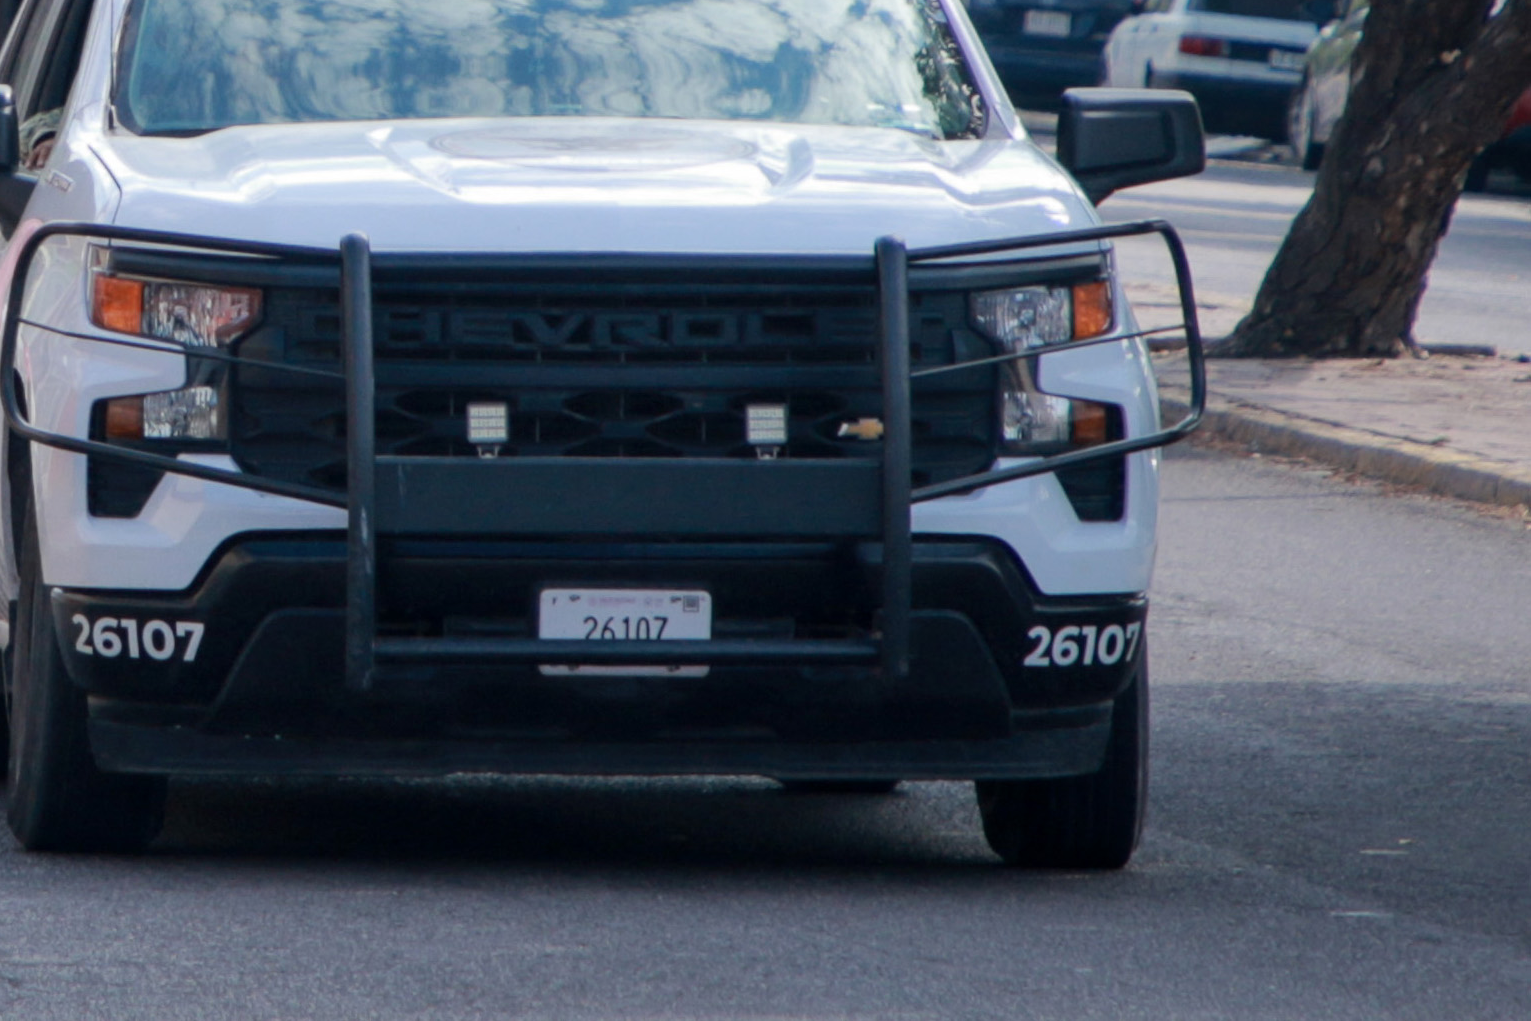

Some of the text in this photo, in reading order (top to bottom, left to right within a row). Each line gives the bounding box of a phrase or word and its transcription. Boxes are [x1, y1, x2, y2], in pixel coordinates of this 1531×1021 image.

[72, 612, 206, 663] 26107
[582, 615, 669, 640] 26107
[1022, 621, 1142, 668] 26107
